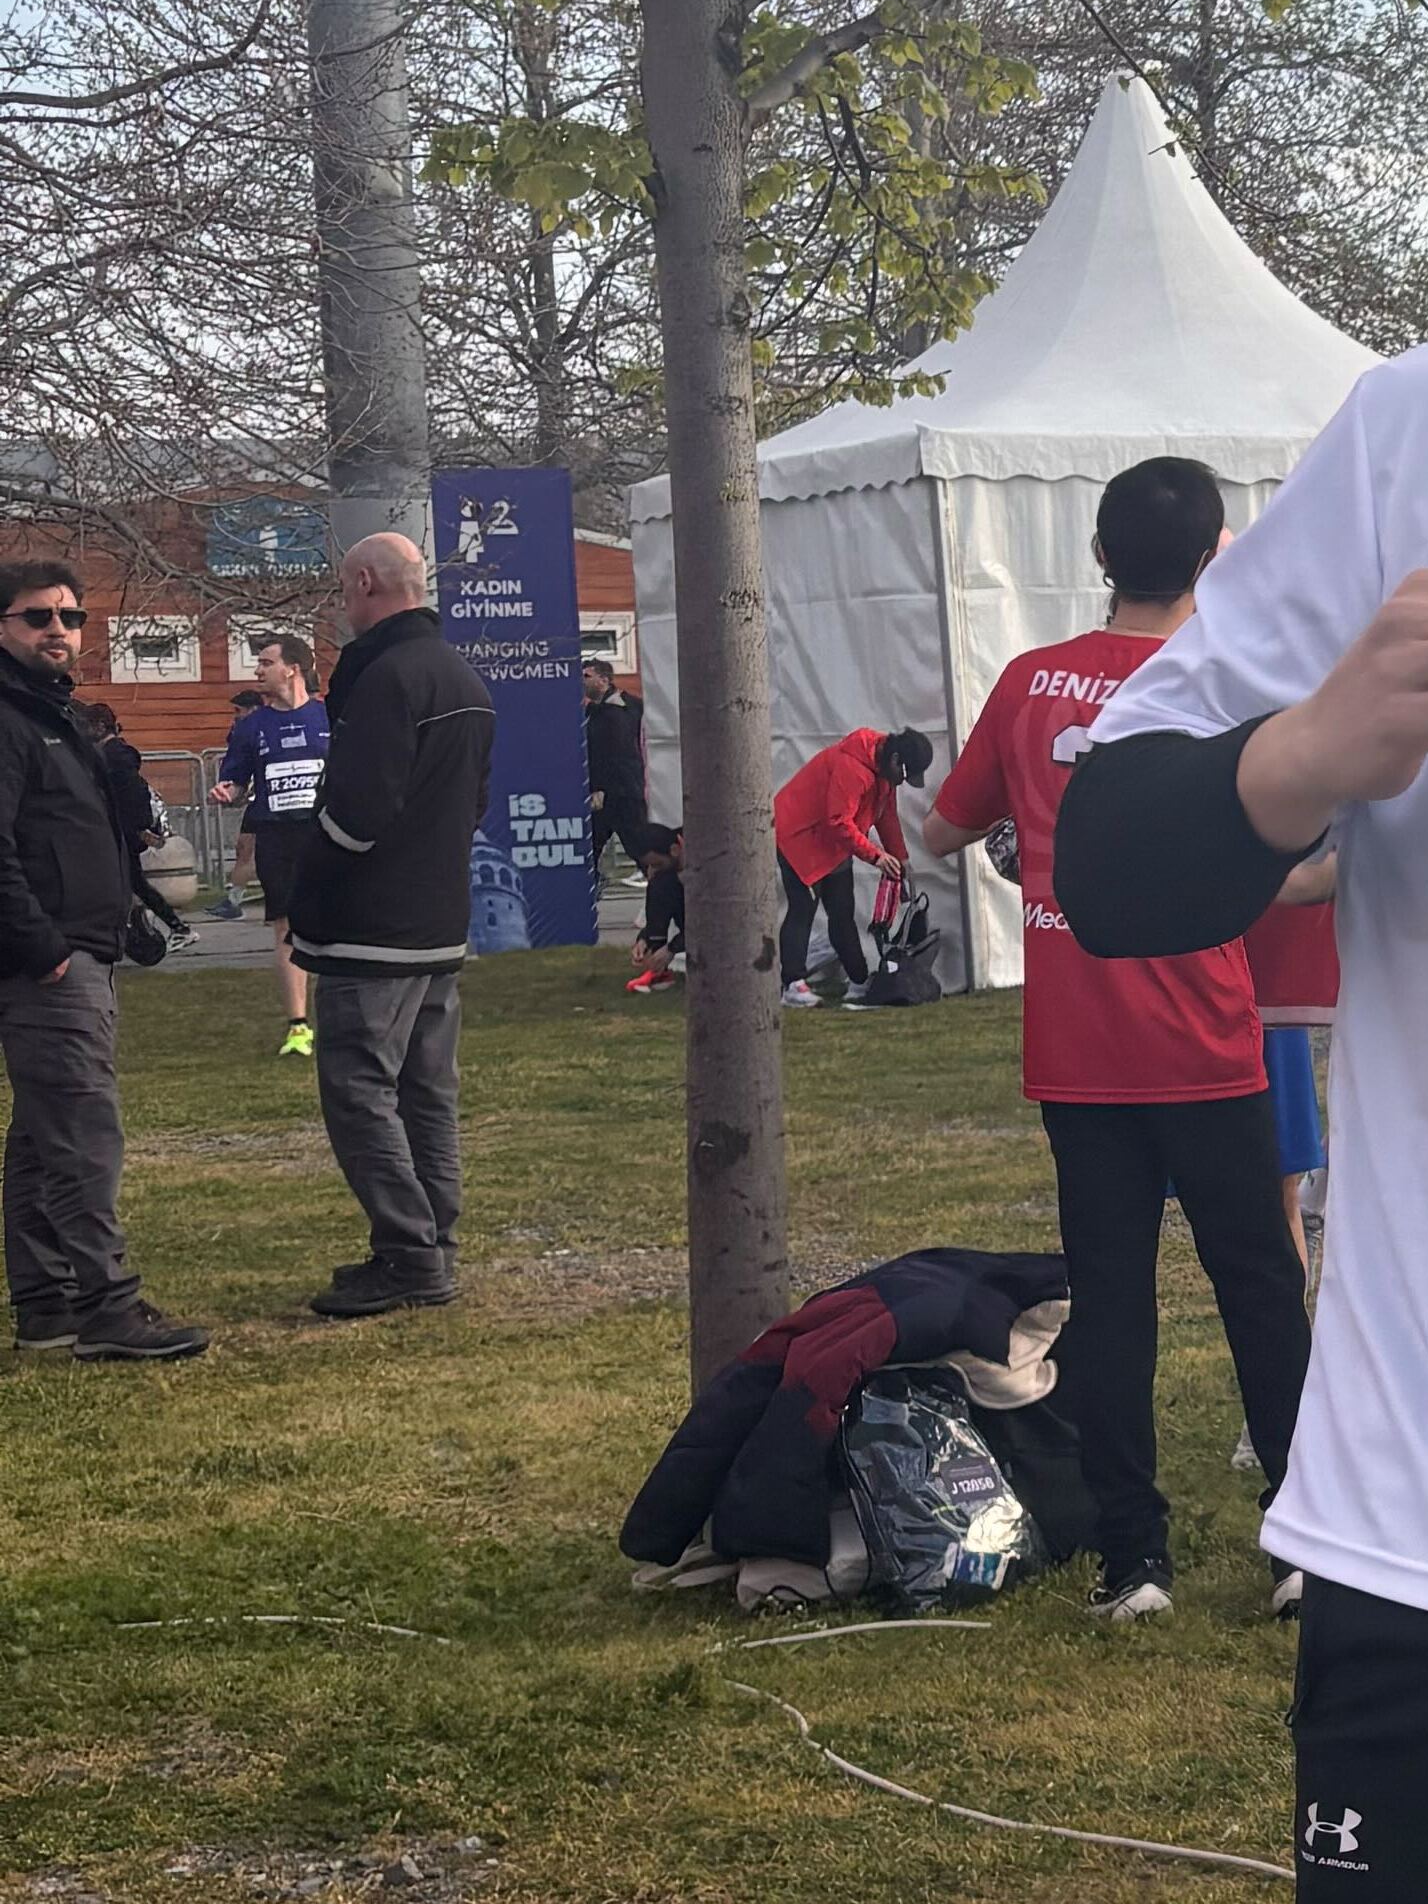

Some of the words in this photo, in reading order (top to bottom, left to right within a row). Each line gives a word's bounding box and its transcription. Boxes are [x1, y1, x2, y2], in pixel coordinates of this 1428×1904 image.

[460, 580, 522, 596] KADIN
[451, 598, 533, 619] GİYİNME
[510, 817, 583, 842] TAN
[512, 844, 585, 868] BUL
